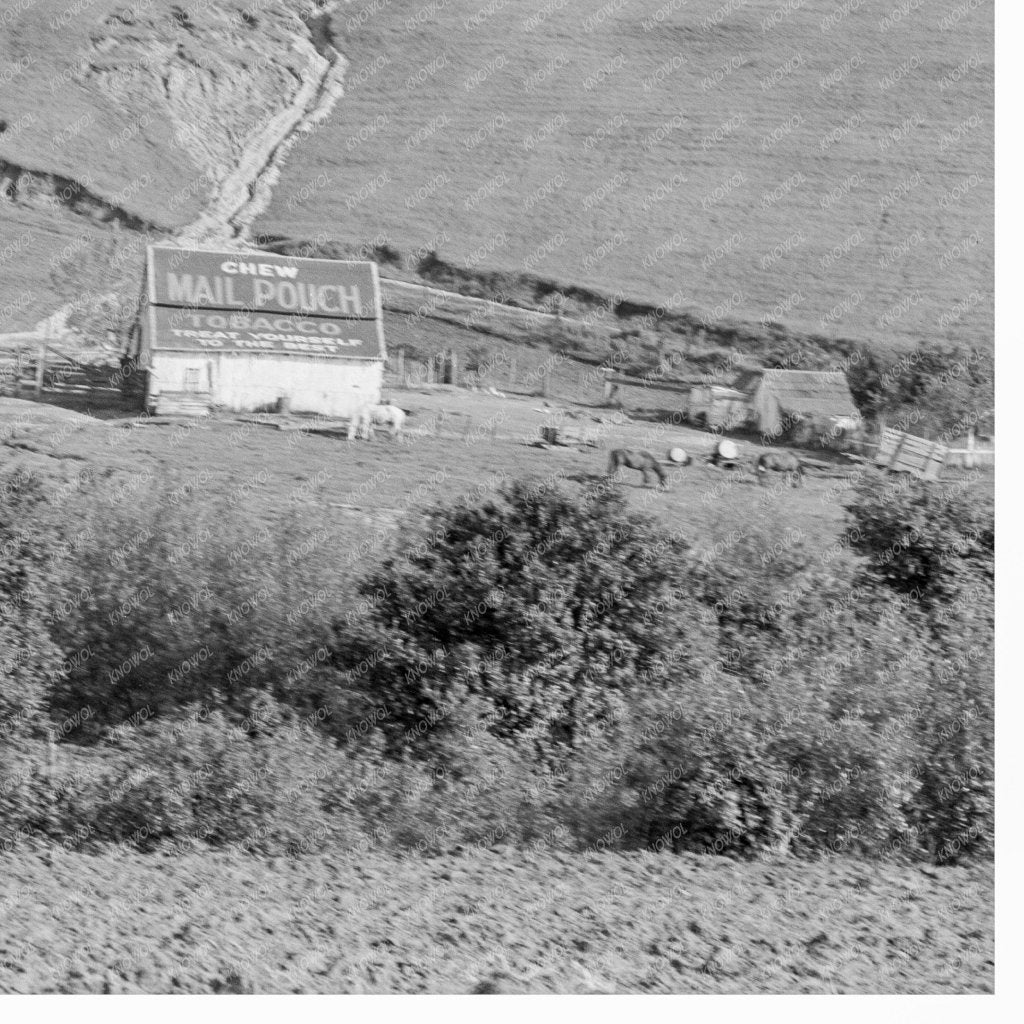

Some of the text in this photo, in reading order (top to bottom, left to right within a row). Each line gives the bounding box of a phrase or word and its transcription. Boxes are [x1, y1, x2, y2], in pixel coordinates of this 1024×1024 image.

[220, 261, 298, 278] CHEW
[166, 272, 363, 315] MAIL POUCH
[190, 314, 341, 334] TOBACCO
[171, 329, 363, 347] TREAT YOURSELF
[196, 338, 338, 353] TO THE BEST
